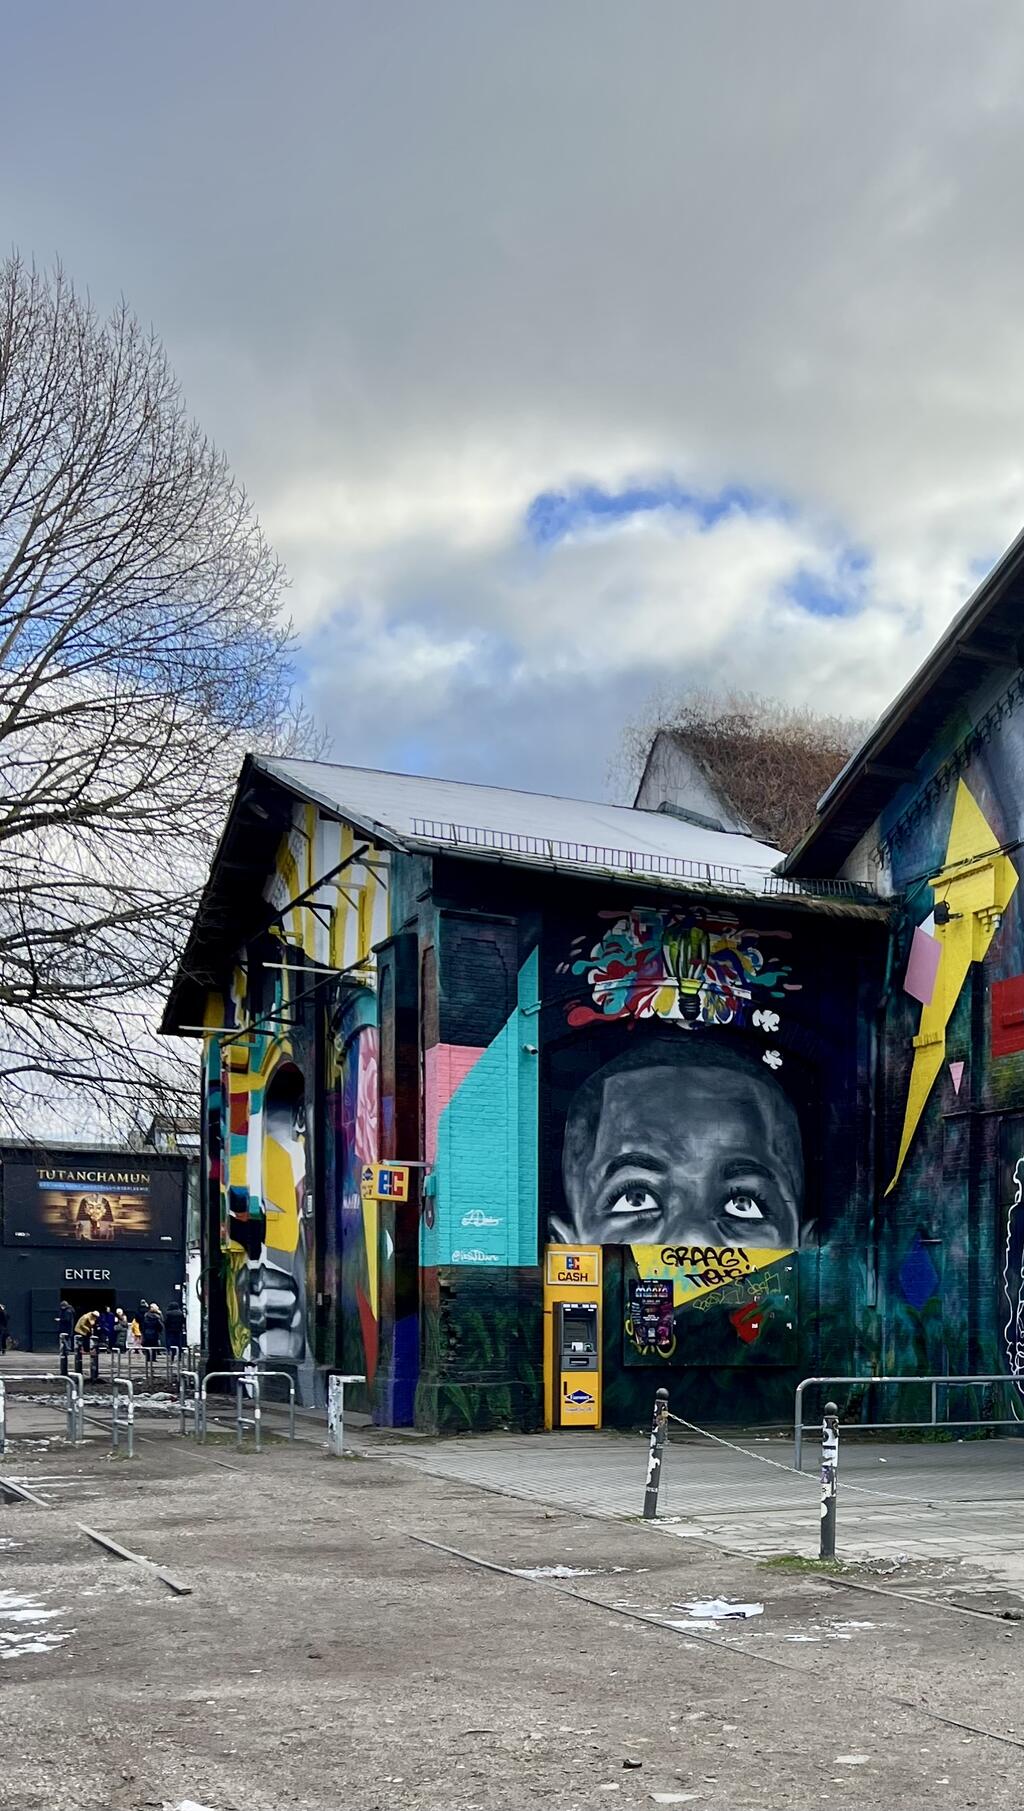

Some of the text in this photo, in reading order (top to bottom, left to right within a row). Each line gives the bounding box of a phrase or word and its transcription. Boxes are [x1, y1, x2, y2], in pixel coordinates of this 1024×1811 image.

[36, 1169, 151, 1184] TUTANCHAMUN
[65, 1268, 111, 1281] ENTER
[557, 1271, 589, 1282] CASH
